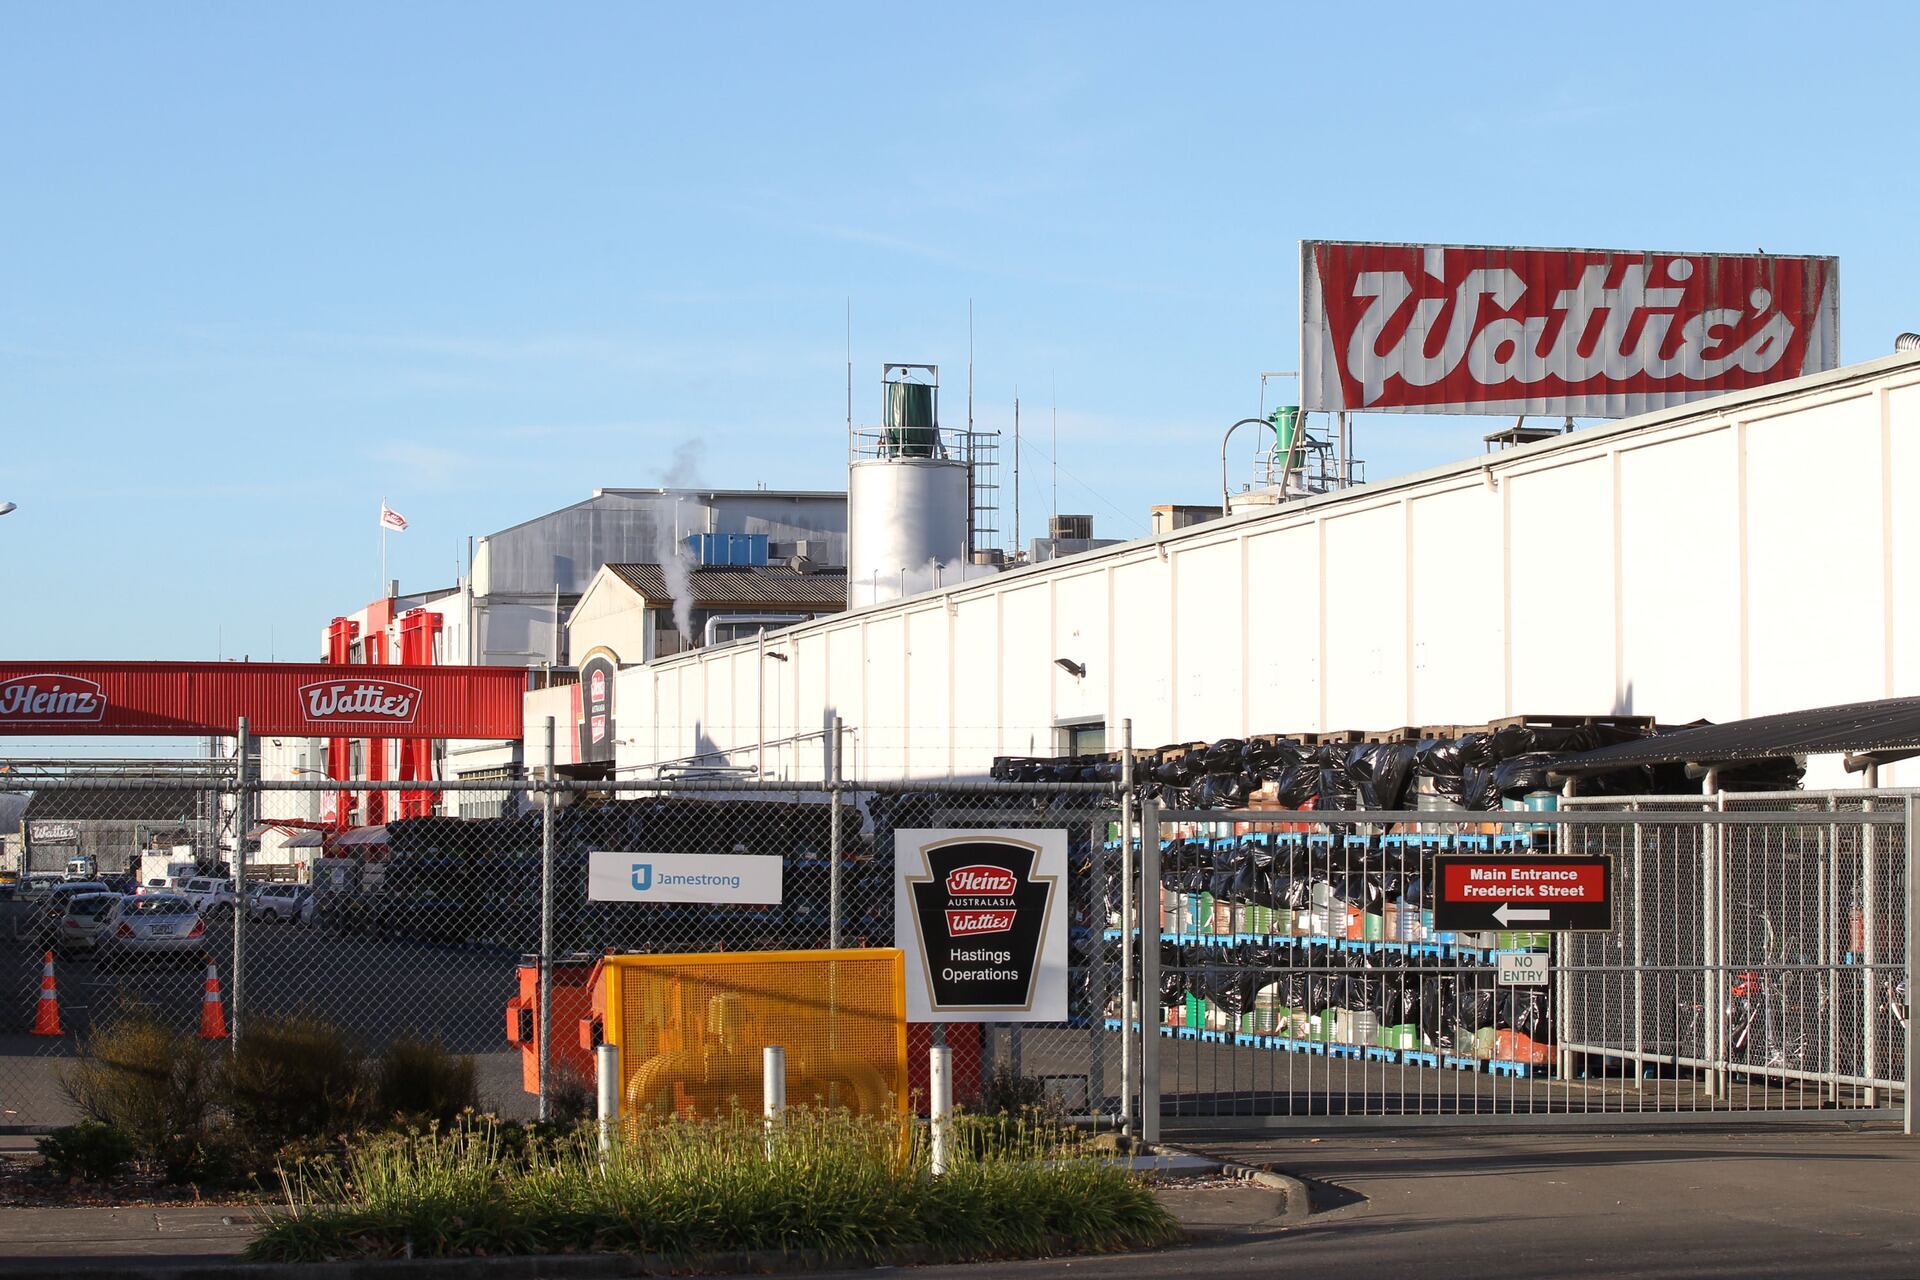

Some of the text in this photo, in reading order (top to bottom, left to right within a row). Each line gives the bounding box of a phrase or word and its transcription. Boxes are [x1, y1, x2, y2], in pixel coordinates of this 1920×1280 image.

[1347, 253, 1796, 392] Wattie's
[0, 685, 97, 713] Heinz
[308, 684, 410, 717] Wattie's
[657, 873, 740, 888] Jamestrong
[951, 871, 1012, 890] Heinz
[1470, 868, 1578, 880] Main Entrance
[1463, 885, 1585, 897] Frederick Street
[948, 898, 1016, 906] AUSTRALASIA
[953, 913, 1009, 931] Wattie's
[950, 948, 1011, 964] Hastings
[1514, 956, 1533, 968] NO
[942, 968, 1019, 983] Operations
[1503, 970, 1544, 981] ENTRY
